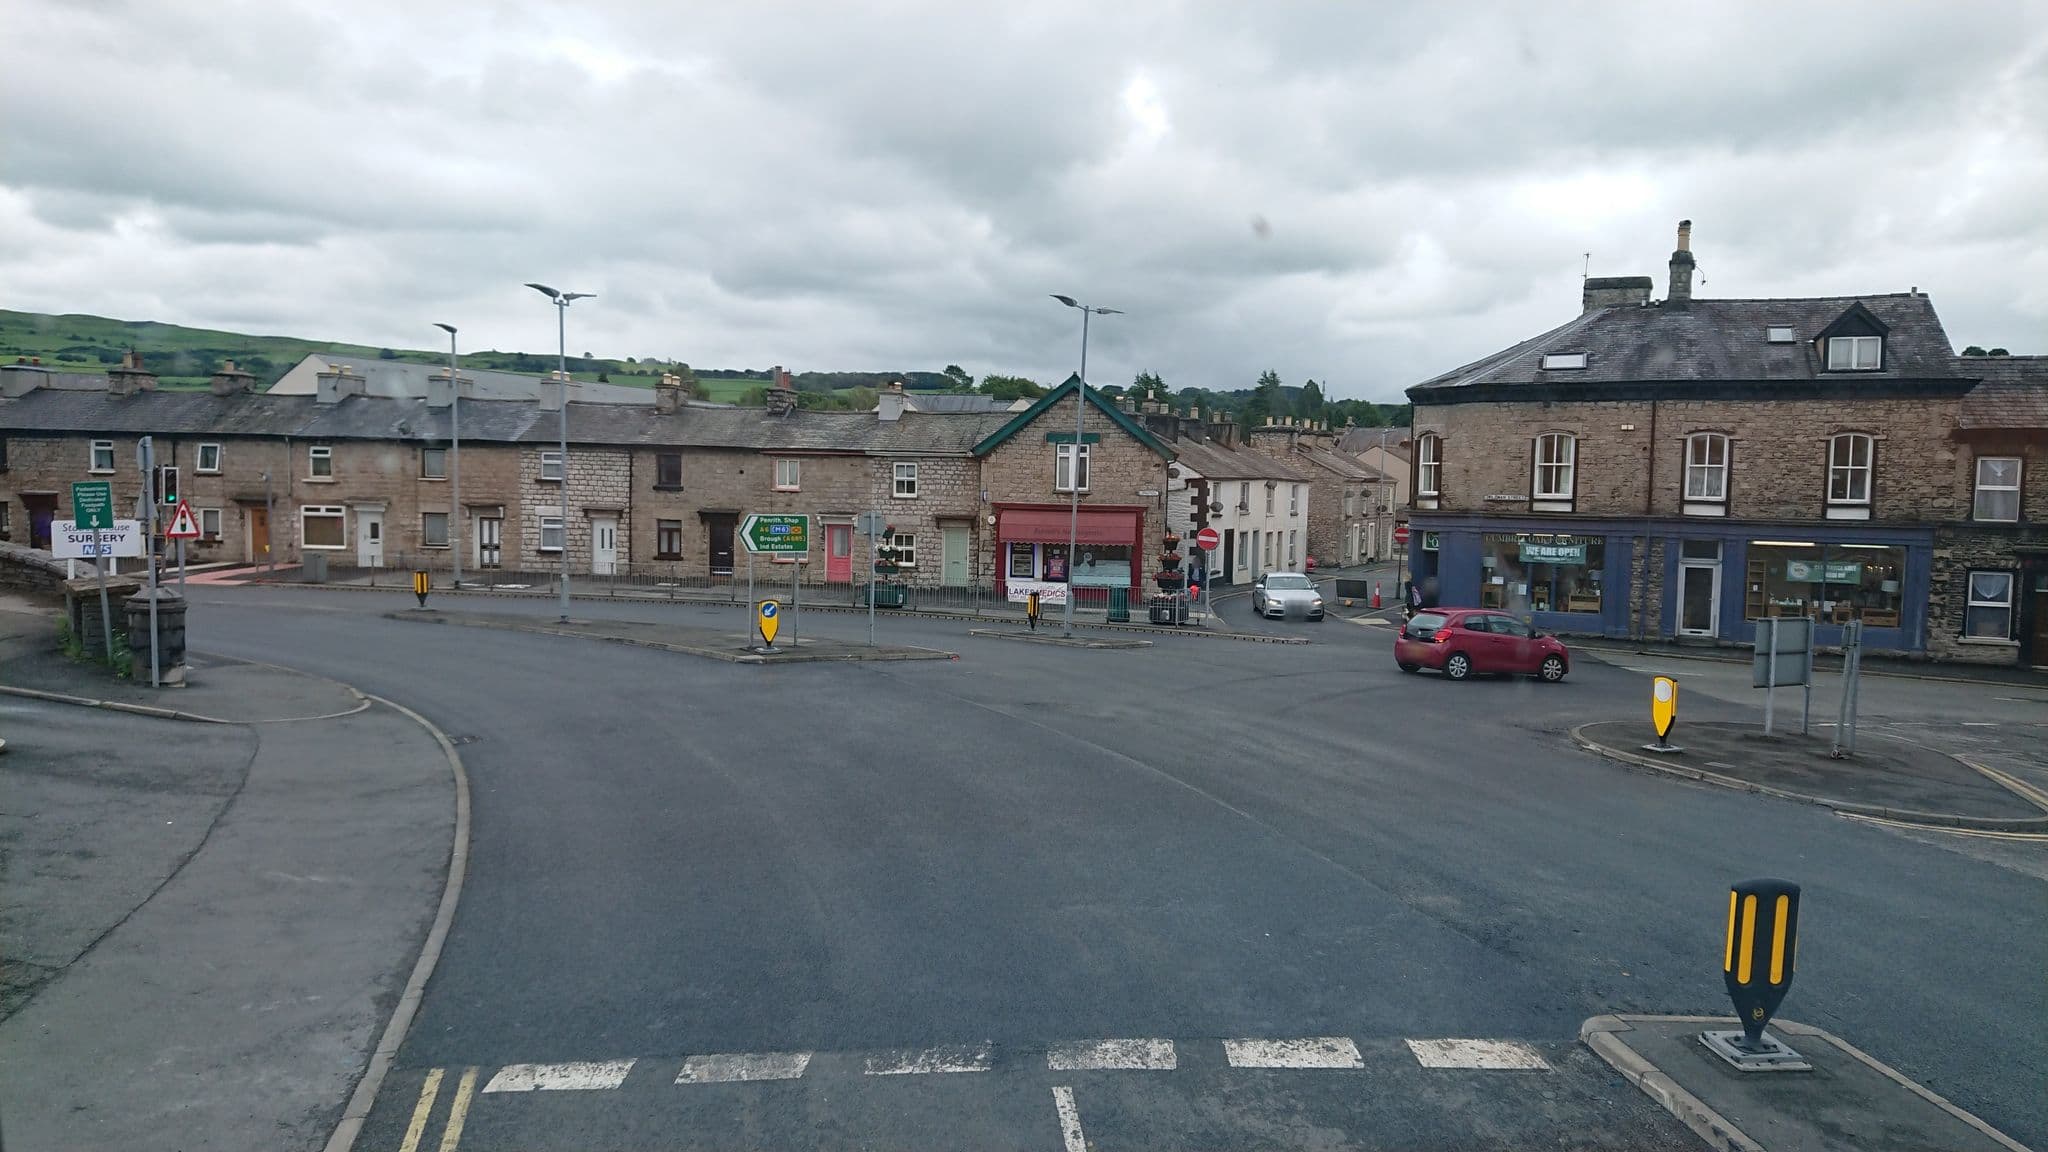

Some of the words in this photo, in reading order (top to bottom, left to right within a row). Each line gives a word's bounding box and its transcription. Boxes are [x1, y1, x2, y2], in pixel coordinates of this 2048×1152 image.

[1525, 546, 1539, 556] WE
[1541, 547, 1557, 556] ARE
[1558, 547, 1580, 556] OPEN
